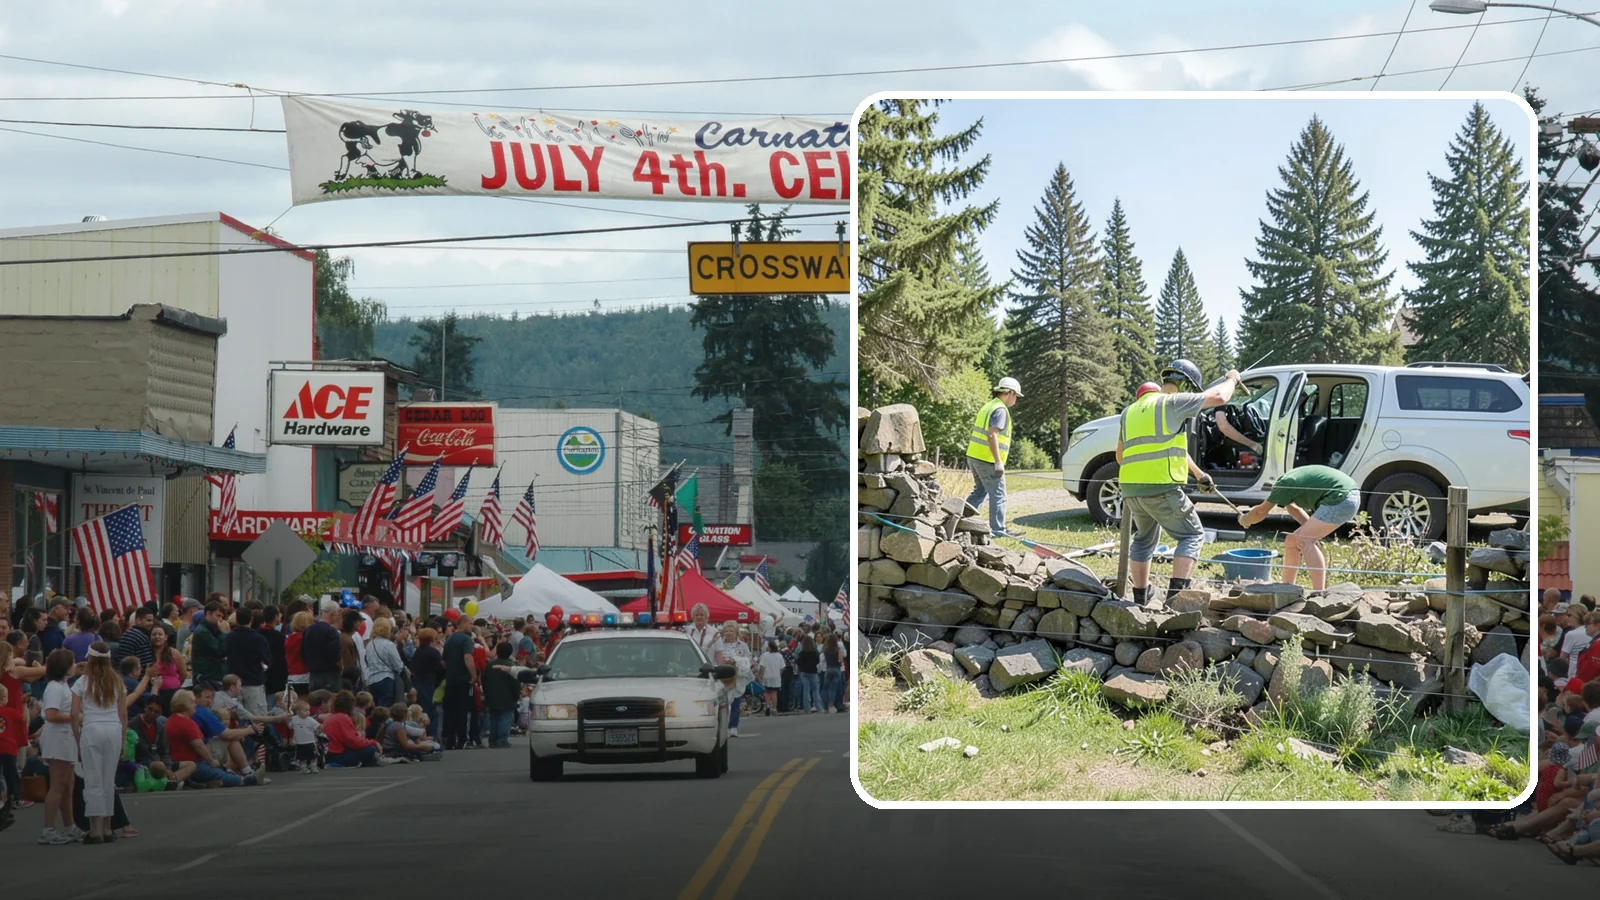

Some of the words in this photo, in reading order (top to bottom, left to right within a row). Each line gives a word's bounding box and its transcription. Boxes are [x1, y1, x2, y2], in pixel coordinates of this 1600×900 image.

[695, 121, 850, 149] Carnat
[481, 141, 605, 193] JULY
[632, 150, 746, 198] 4th.
[696, 254, 850, 280] CROSSWA
[282, 379, 374, 420] ACE
[405, 410, 452, 422] CEDAR
[283, 421, 370, 436] Hardware
[416, 428, 477, 447] Coca-Cola
[95, 485, 124, 495] Vincent
[126, 486, 135, 494] de
[138, 486, 155, 495] Paul
[688, 527, 741, 535] CRNATION
[700, 535, 730, 543] GLASS
